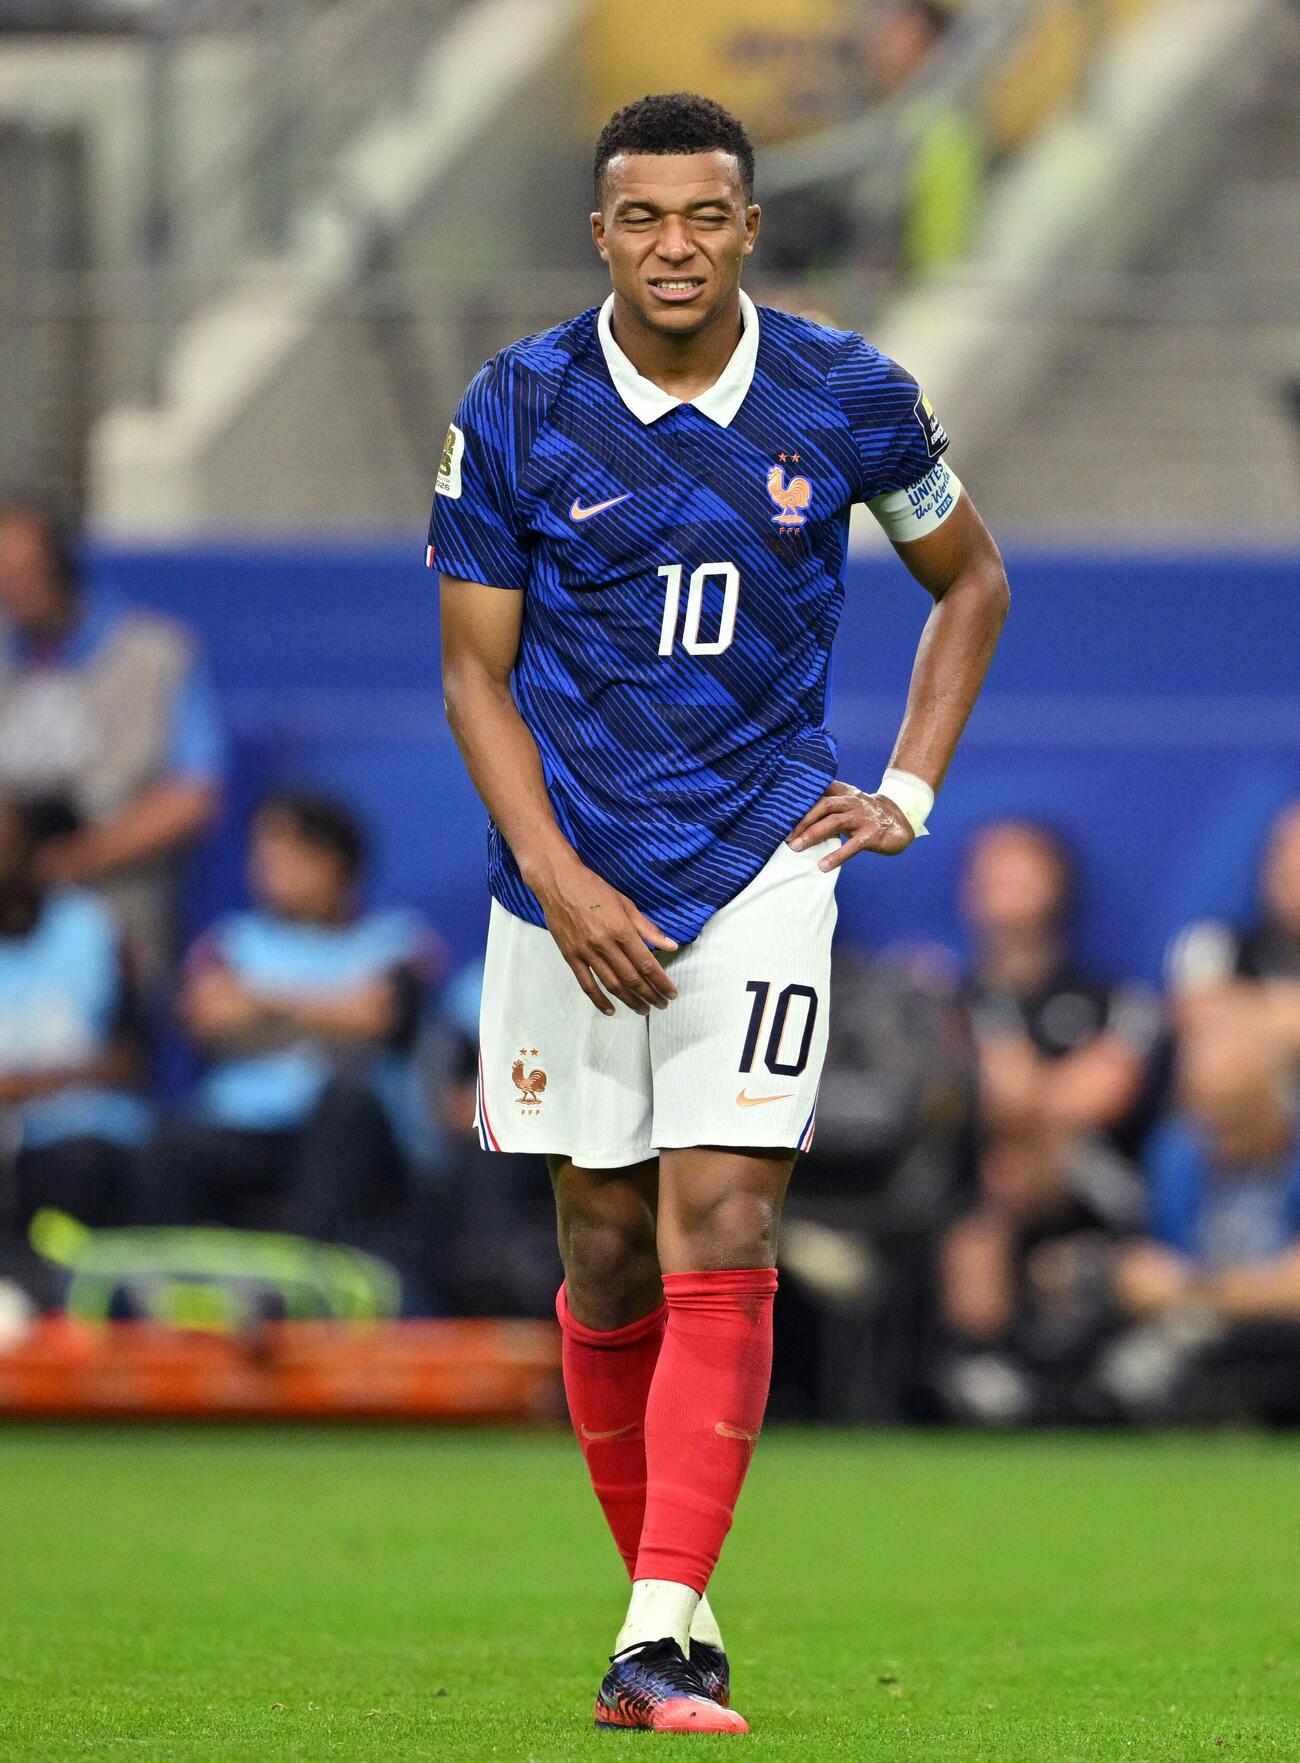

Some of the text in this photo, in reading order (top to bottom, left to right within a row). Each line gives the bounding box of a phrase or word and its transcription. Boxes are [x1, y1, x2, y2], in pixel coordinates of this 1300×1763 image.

[908, 463, 944, 506] UNITES
[937, 496, 952, 516] FIFA
[912, 502, 933, 519] the
[657, 561, 740, 656] 10
[738, 980, 818, 1077] 10
